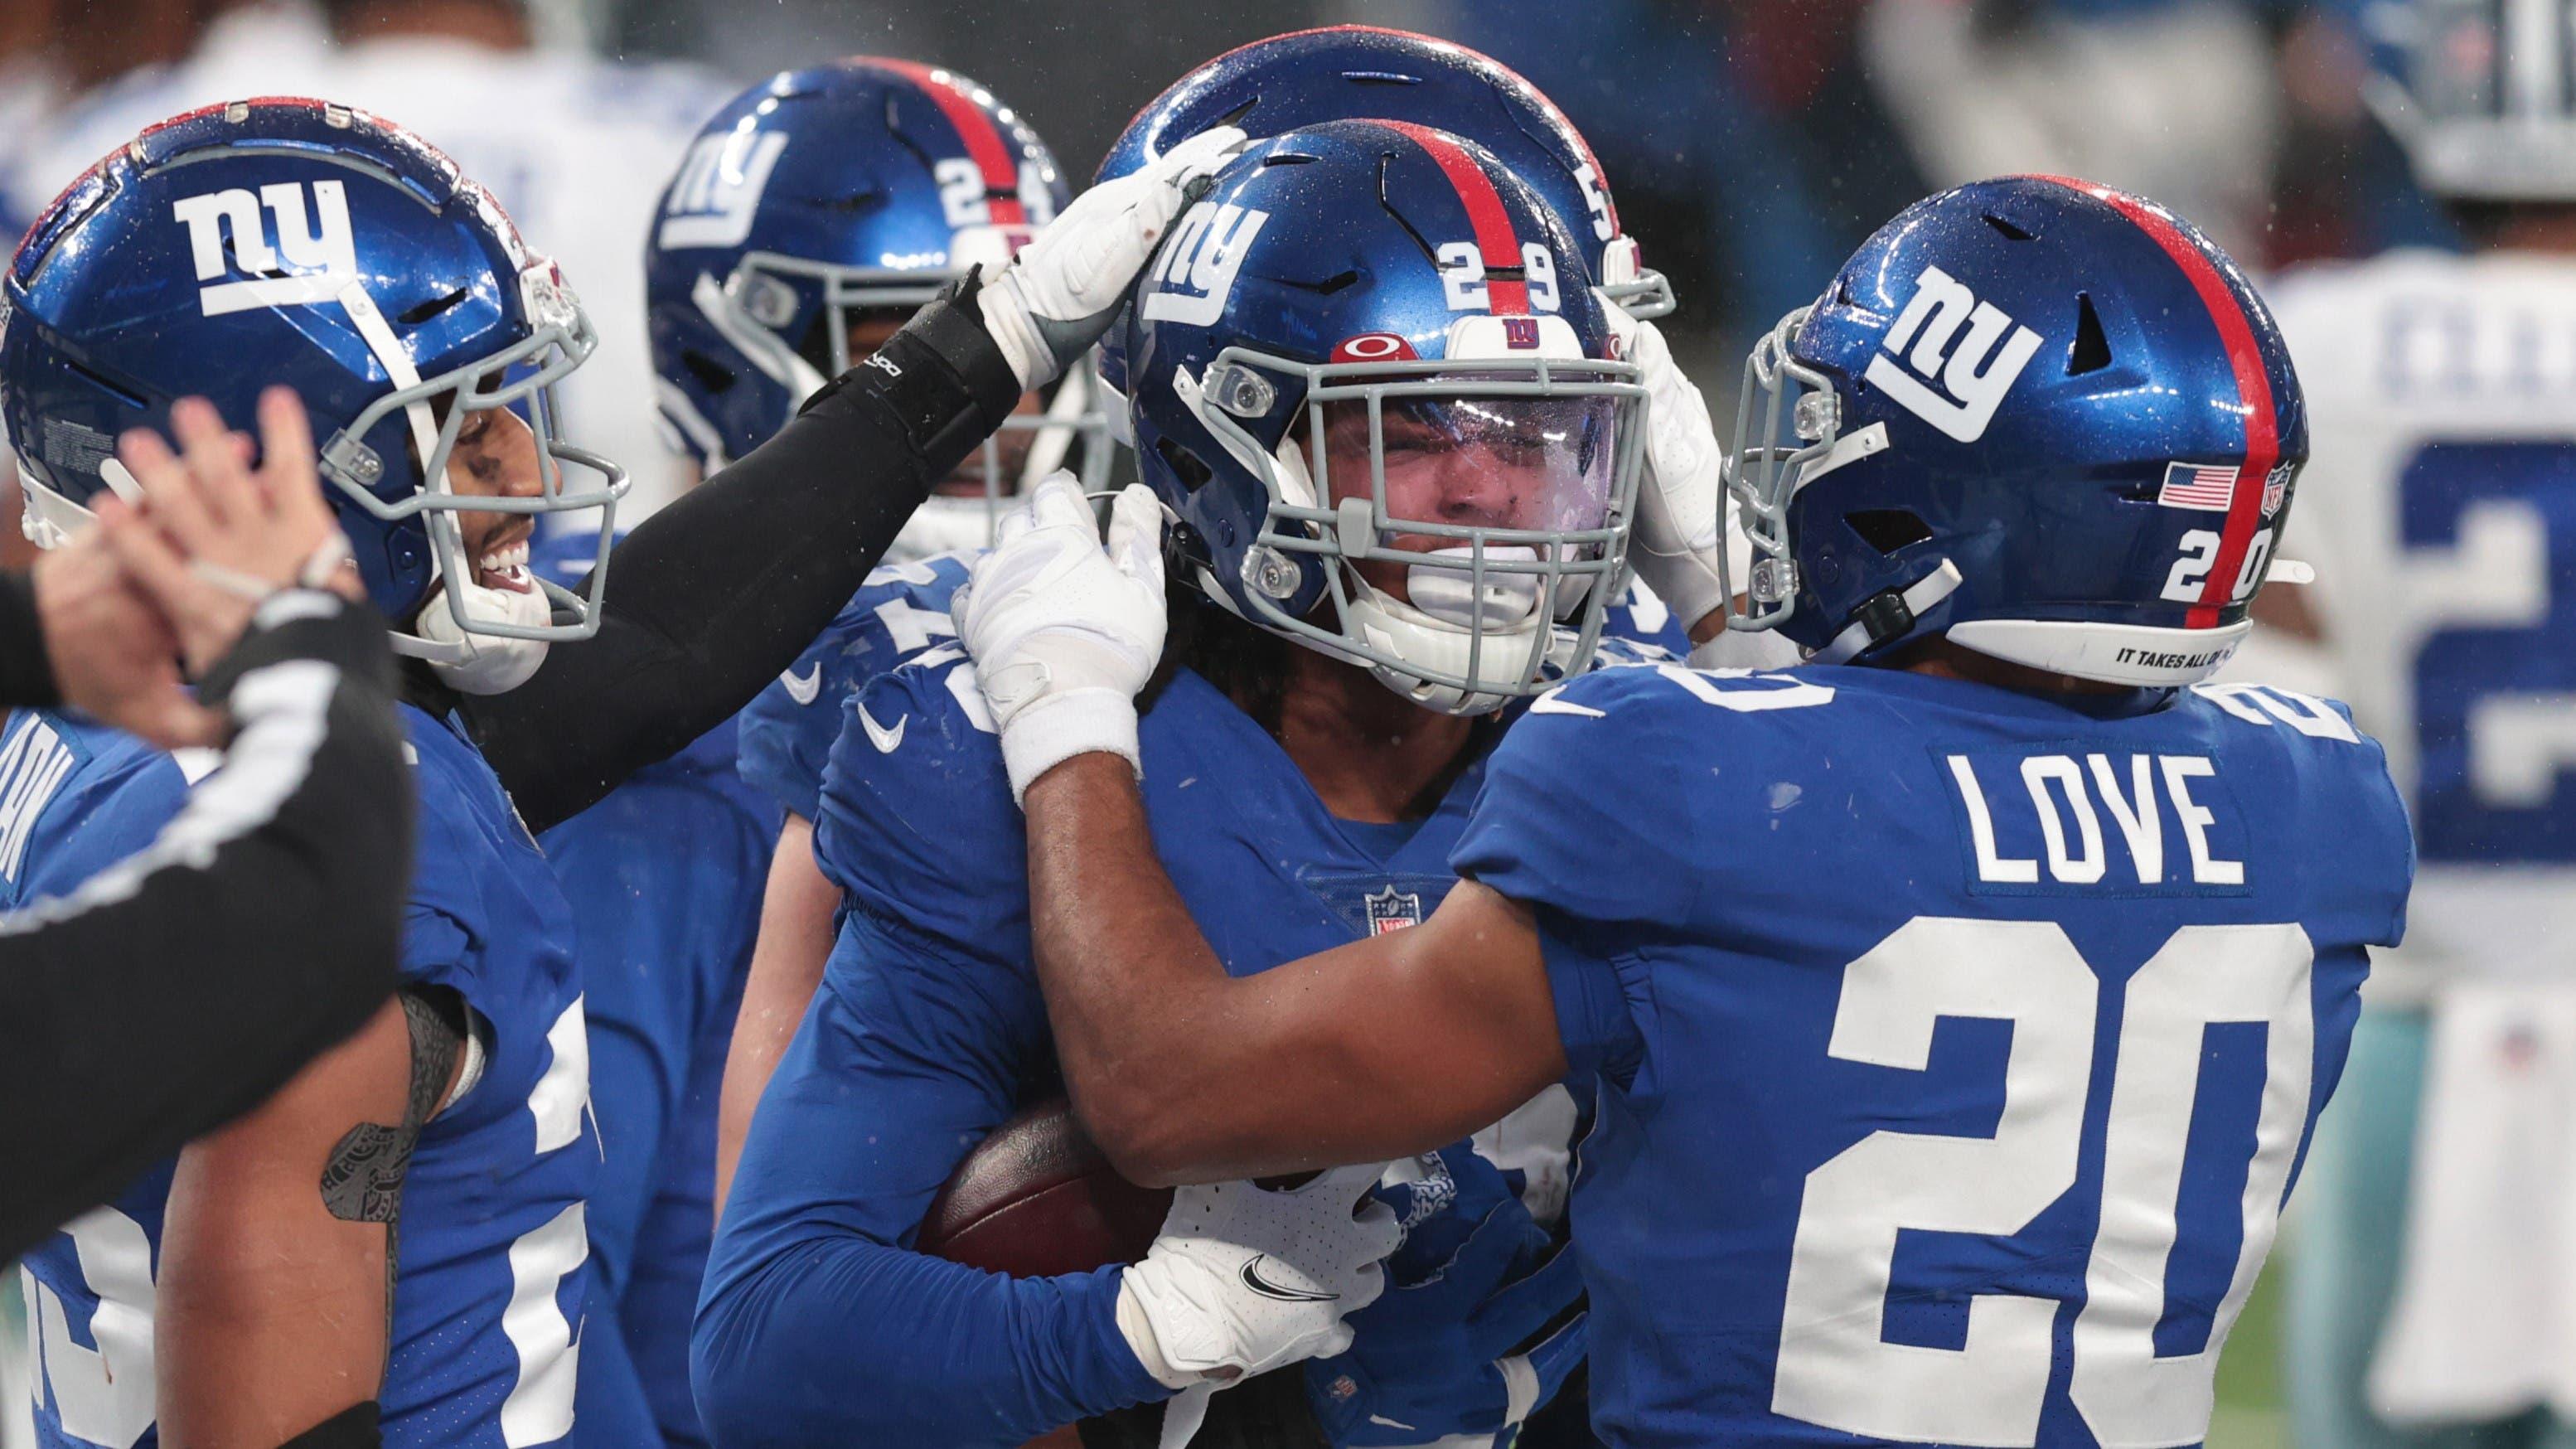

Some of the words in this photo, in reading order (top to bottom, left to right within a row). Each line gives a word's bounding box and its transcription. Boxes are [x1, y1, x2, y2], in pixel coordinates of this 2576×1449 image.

[173, 180, 357, 317] ny
[1437, 241, 1562, 312] 29
[1865, 264, 2045, 443] ny
[2160, 528, 2273, 603] 20
[2116, 648, 2136, 662] IT
[2137, 651, 2187, 668] TAKES
[2184, 652, 2208, 668] ALL
[1948, 754, 2244, 884] LOVE
[1771, 916, 2314, 1449] 20
